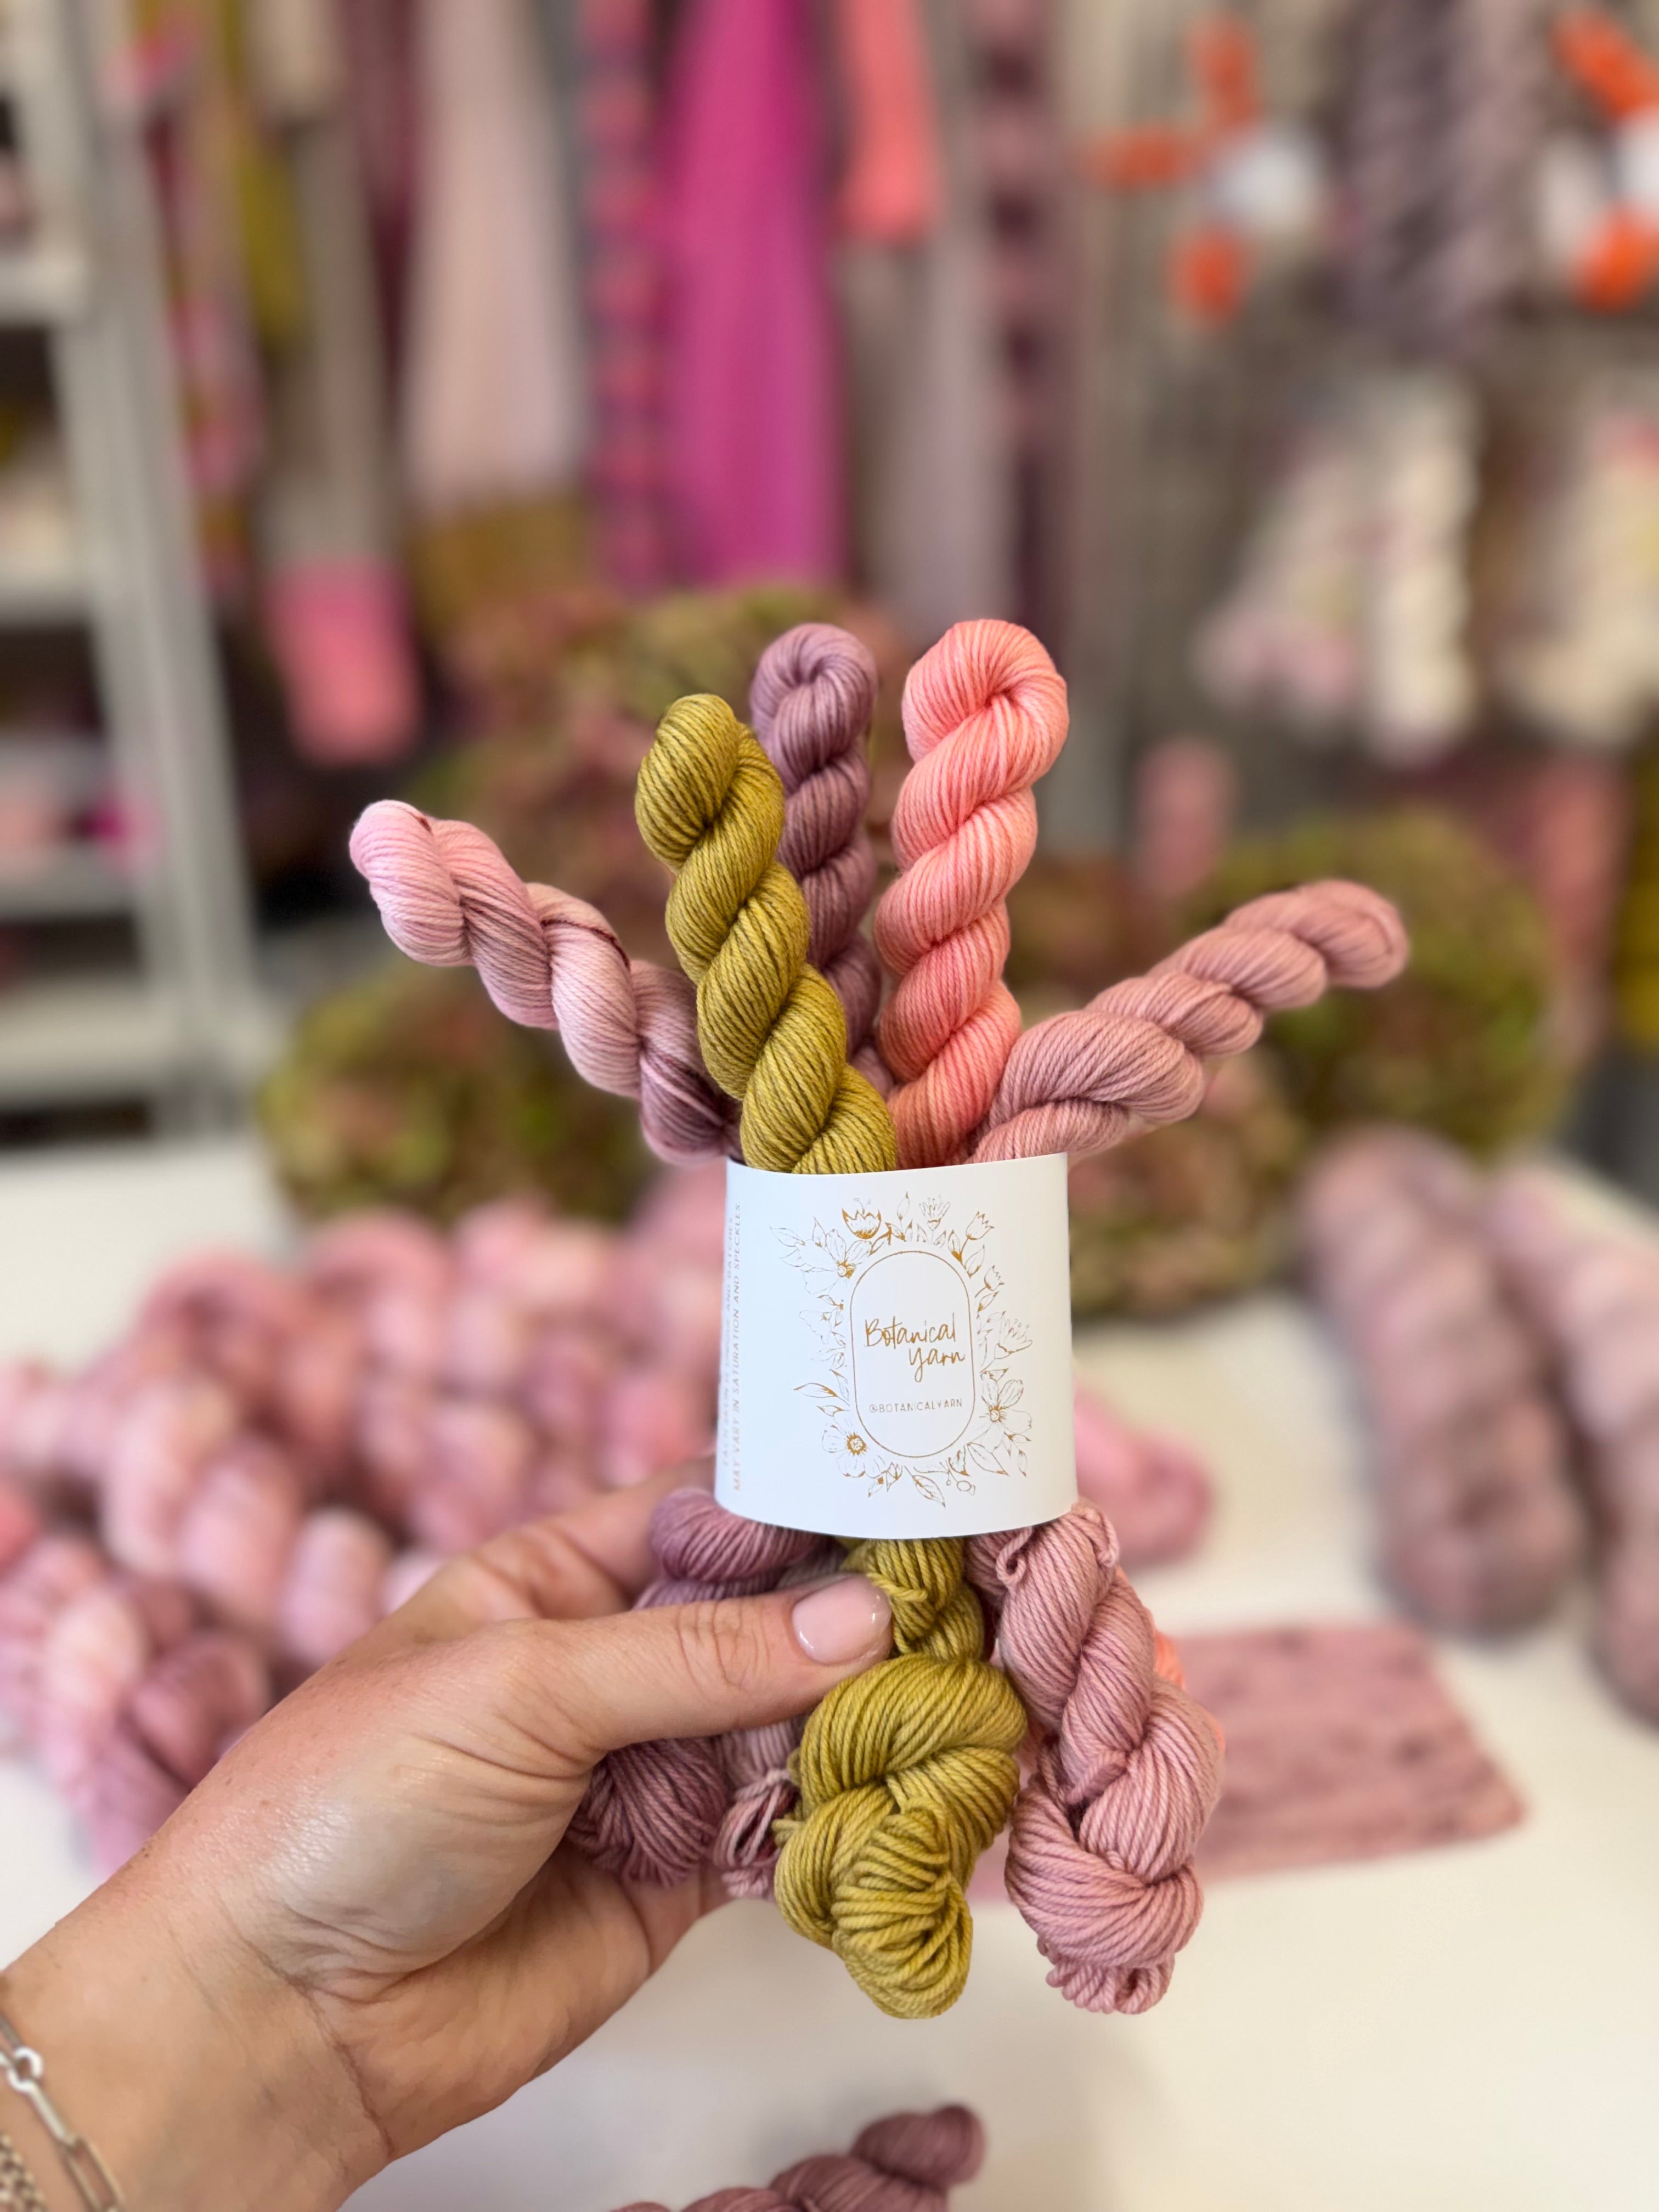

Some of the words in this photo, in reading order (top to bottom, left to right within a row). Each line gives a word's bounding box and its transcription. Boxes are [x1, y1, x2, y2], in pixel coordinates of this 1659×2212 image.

[865, 1312, 956, 1350] Botanical
[732, 1400, 740, 1413] IN
[869, 1398, 963, 1413] @BOTANICALYARN
[732, 1461, 741, 1491] MAY
